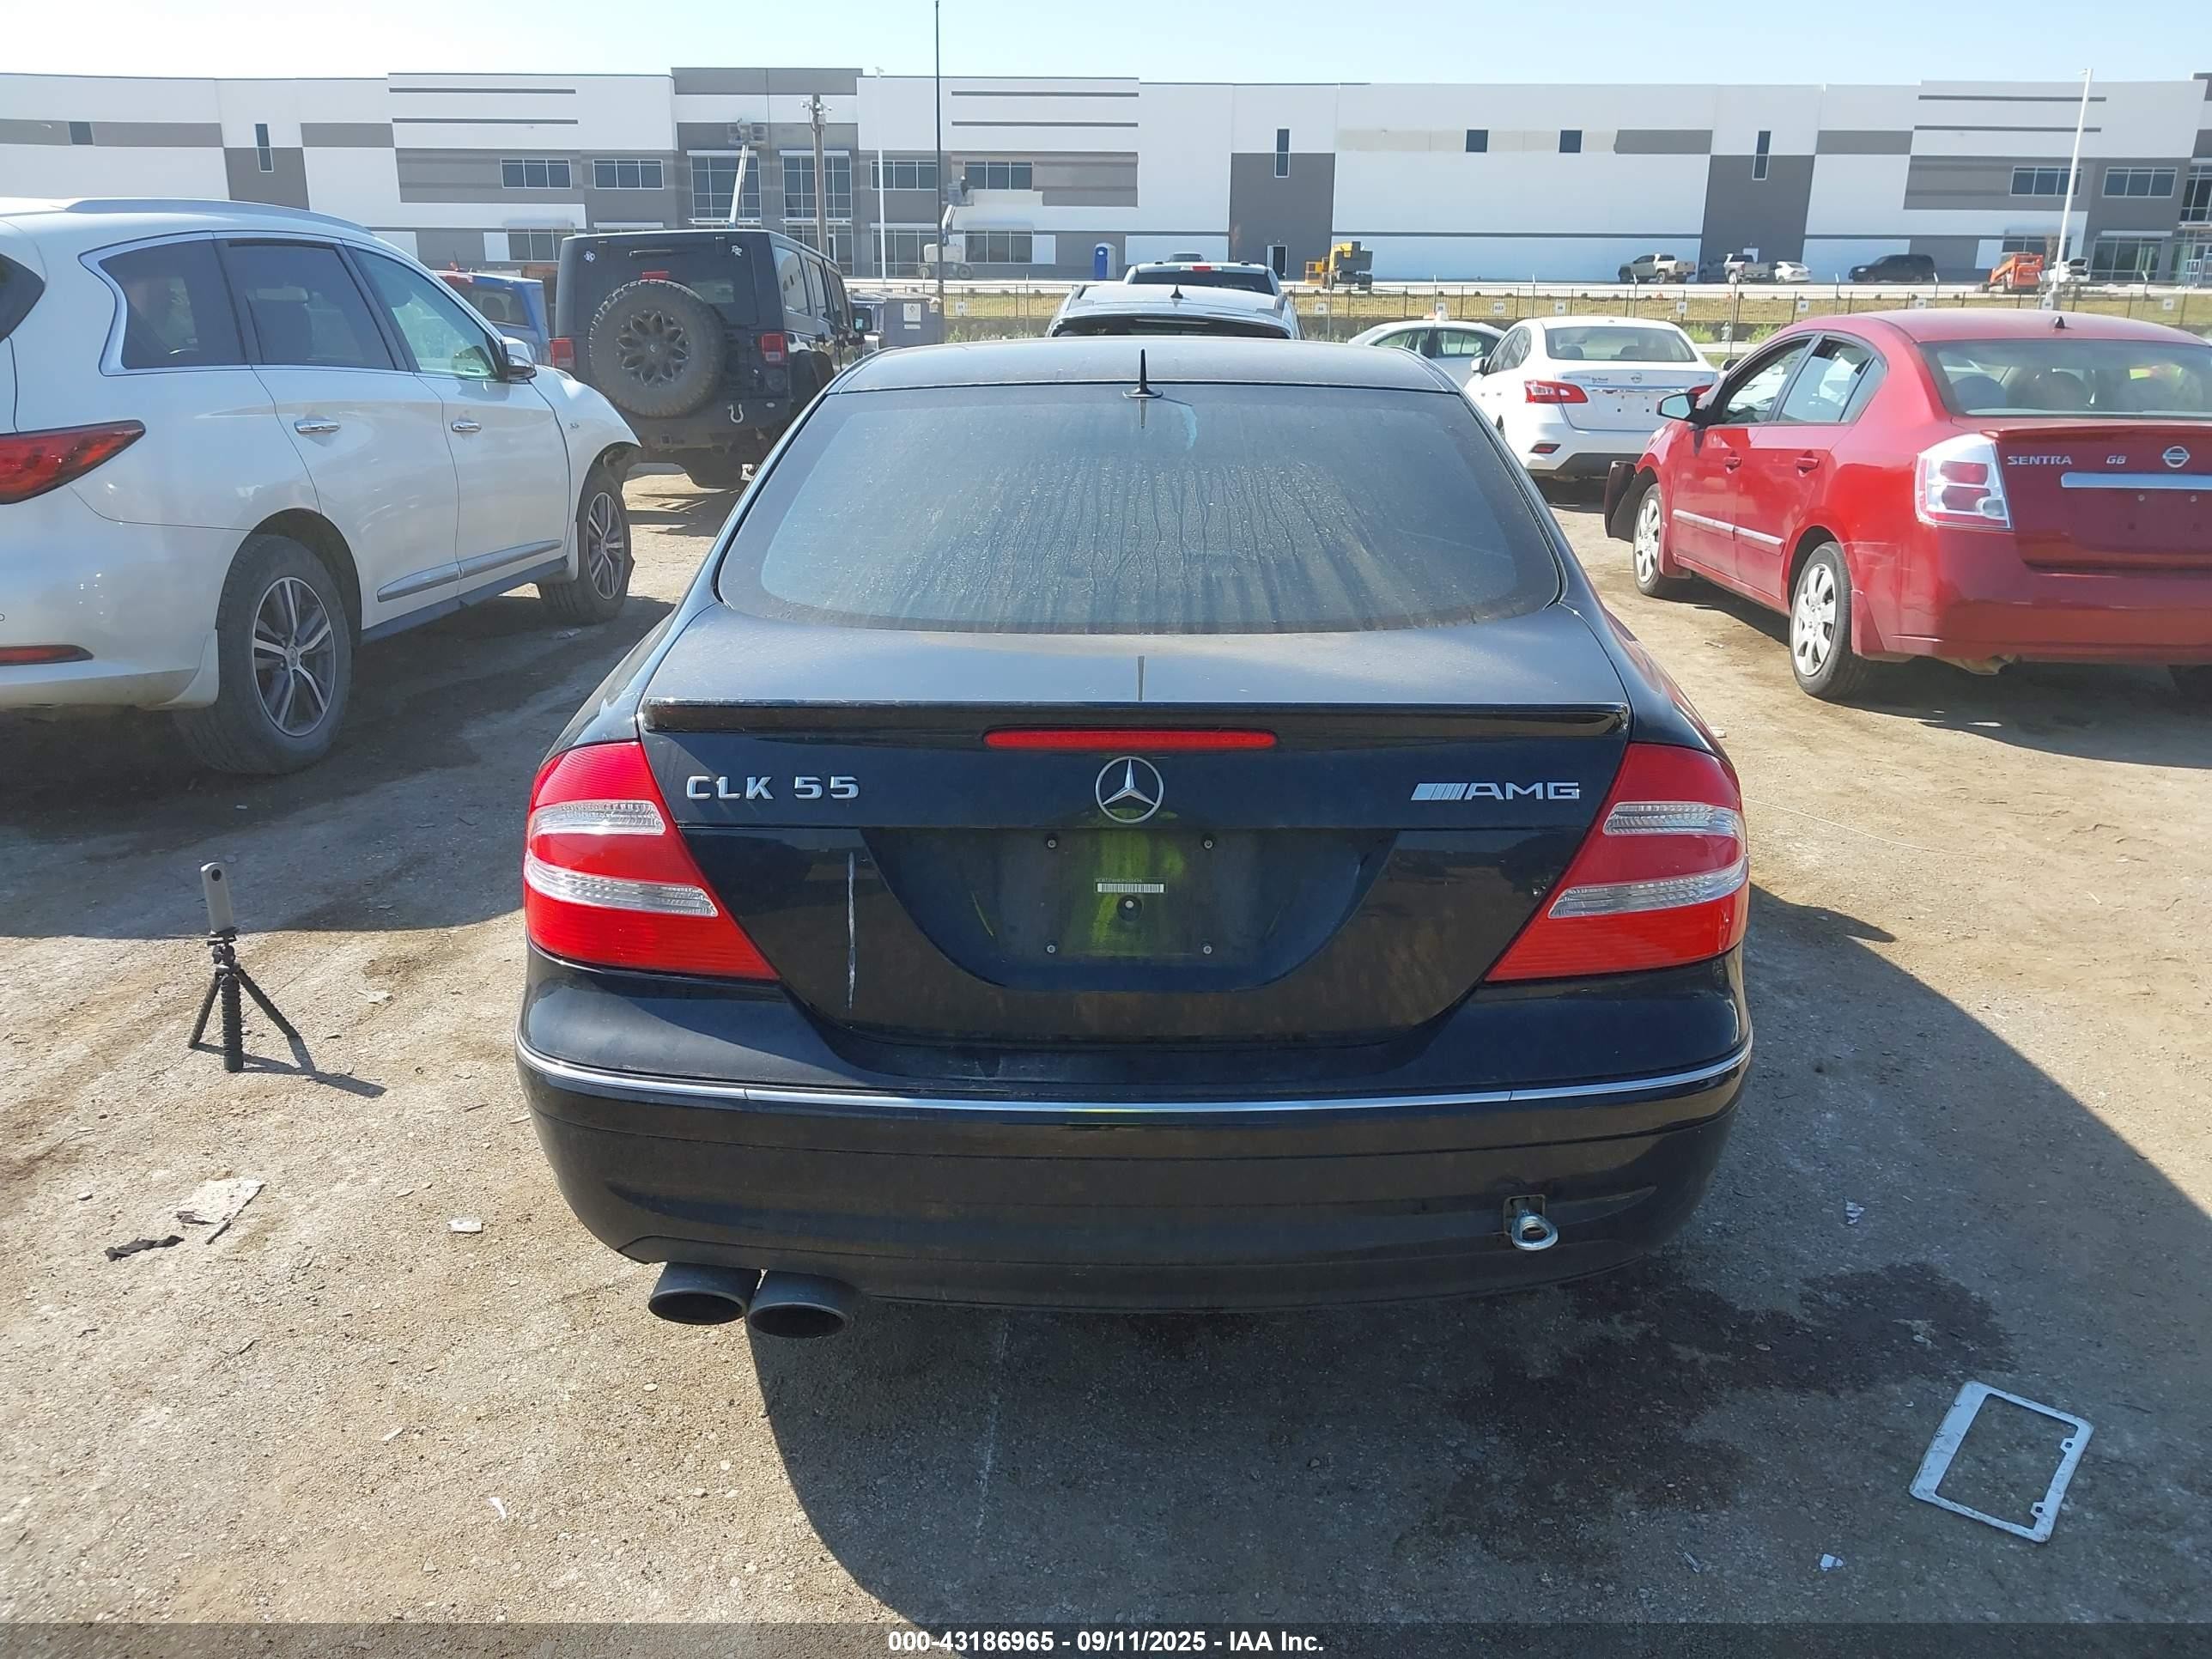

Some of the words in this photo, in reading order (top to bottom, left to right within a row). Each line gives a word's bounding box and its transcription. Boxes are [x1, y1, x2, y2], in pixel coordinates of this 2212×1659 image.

[2007, 455, 2073, 466] SENTRA
[686, 775, 774, 800] CLK
[794, 775, 860, 800] 55
[1464, 781, 1580, 800] AMG
